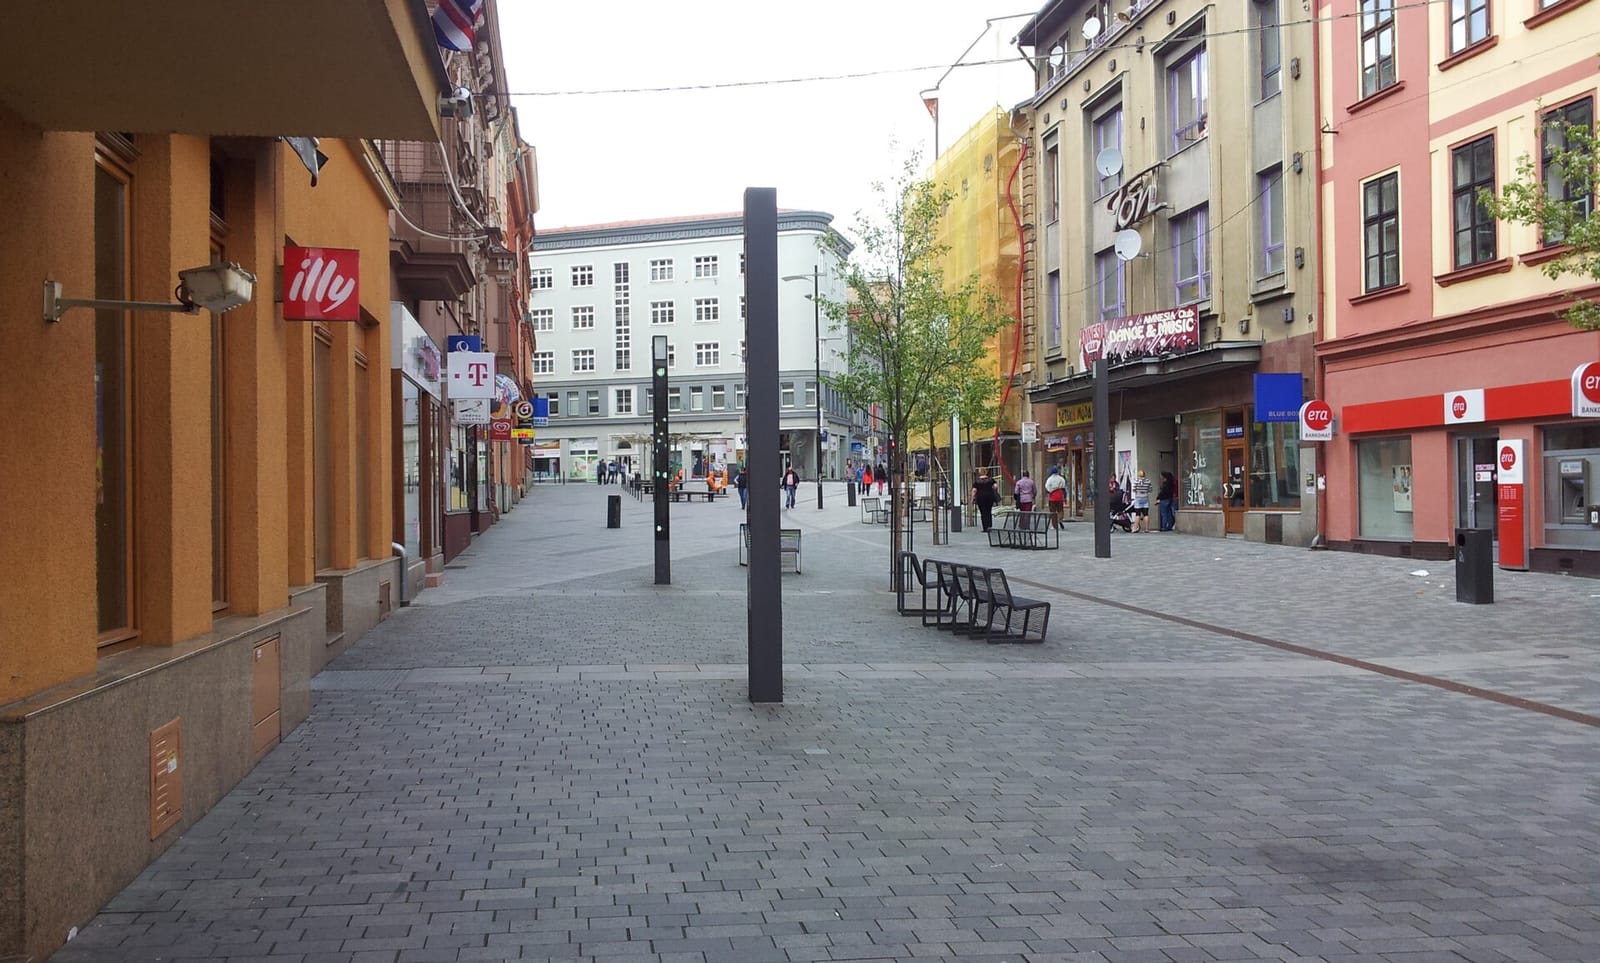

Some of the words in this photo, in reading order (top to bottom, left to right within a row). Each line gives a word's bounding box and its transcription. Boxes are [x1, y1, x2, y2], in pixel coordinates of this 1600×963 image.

[288, 257, 355, 313] illy
[1143, 311, 1177, 324] AMNESIA
[1178, 308, 1195, 319] Club
[1109, 324, 1145, 343] DANCE
[1145, 323, 1156, 338] &
[1158, 318, 1194, 336] MUSIC
[468, 363, 488, 386] T
[1585, 375, 1600, 389] er
[1453, 402, 1465, 411] era
[1307, 410, 1328, 420] era
[1501, 453, 1514, 462] era
